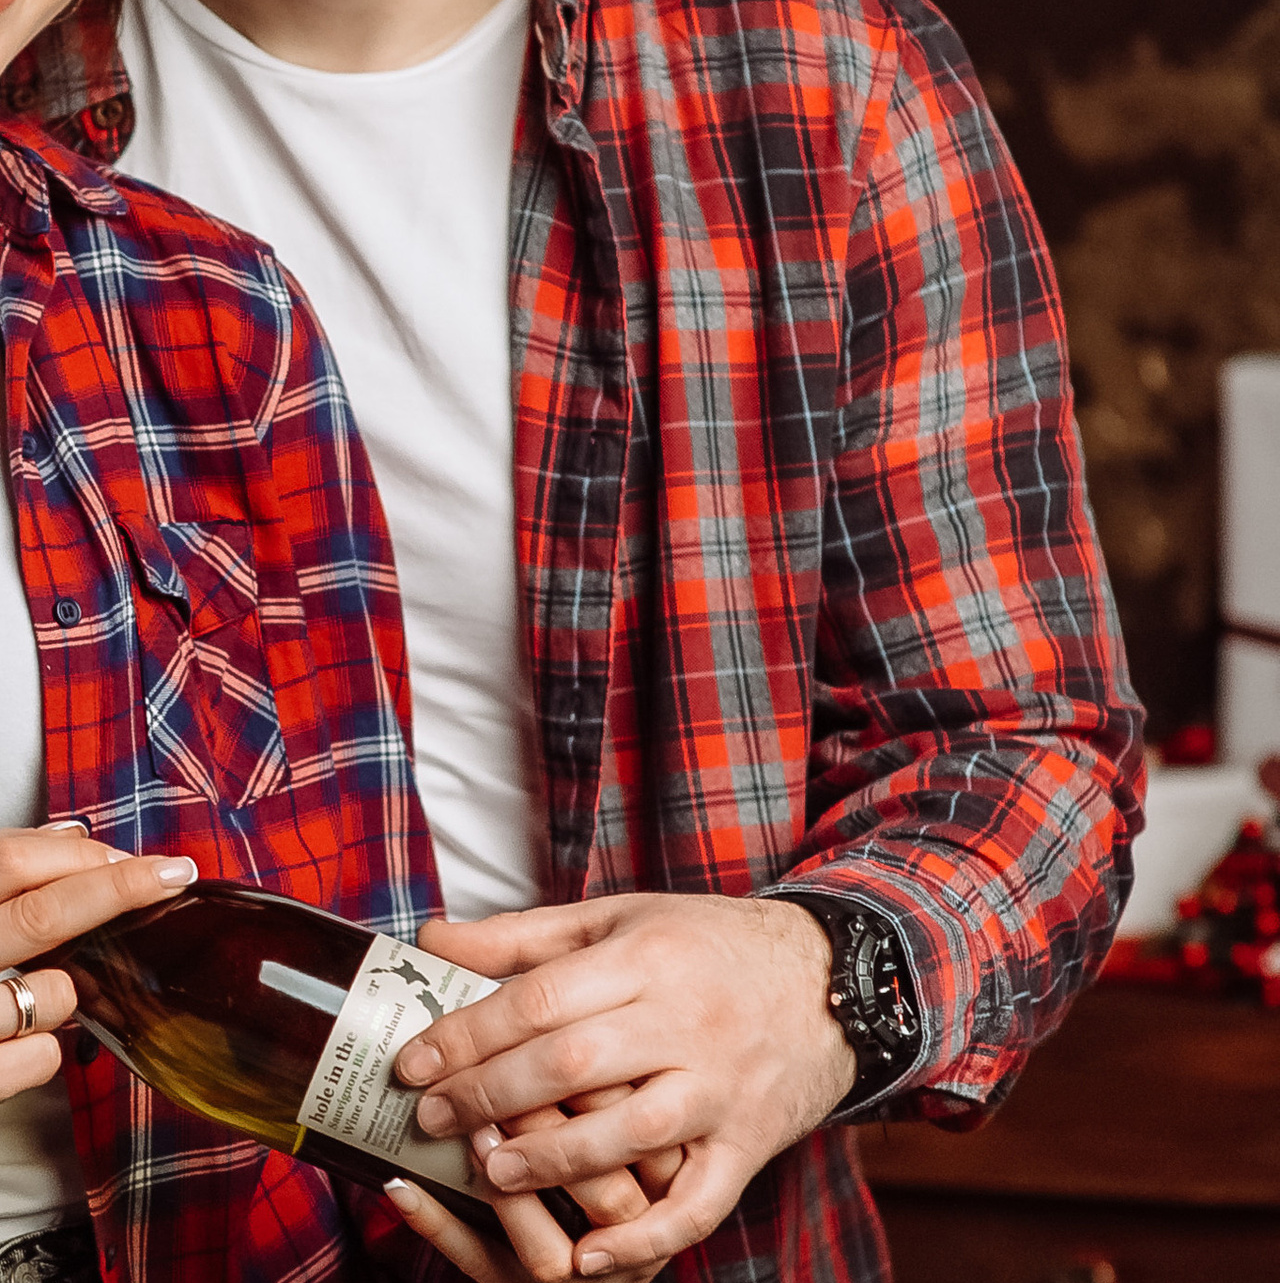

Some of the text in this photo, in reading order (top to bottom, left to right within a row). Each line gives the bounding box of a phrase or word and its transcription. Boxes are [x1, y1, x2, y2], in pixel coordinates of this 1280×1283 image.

[376, 1002, 406, 1055] Zealand
[308, 1086, 335, 1125] hole
[325, 1064, 344, 1085] in
[336, 1031, 358, 1062] the
[363, 1056, 383, 1087] New
[327, 1069, 359, 1130] Sauvignon
[359, 1084, 369, 1103] of
[343, 1104, 363, 1137] Wine
